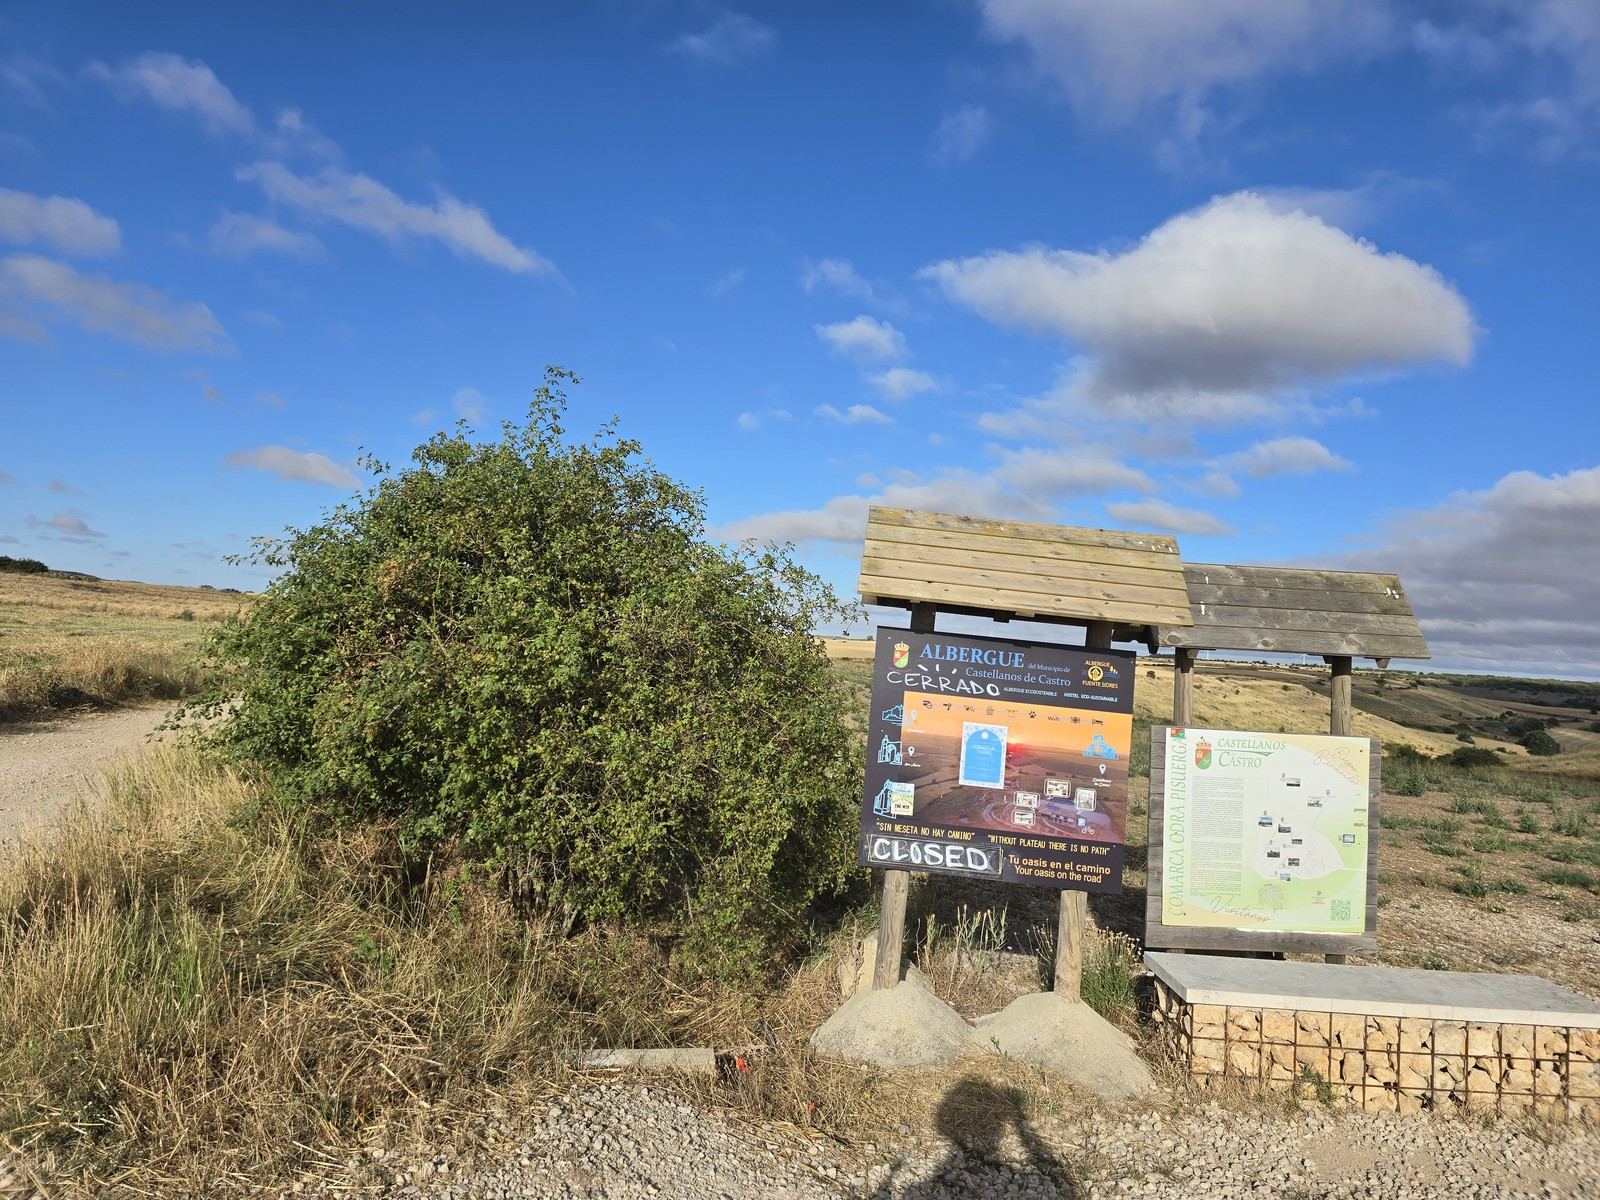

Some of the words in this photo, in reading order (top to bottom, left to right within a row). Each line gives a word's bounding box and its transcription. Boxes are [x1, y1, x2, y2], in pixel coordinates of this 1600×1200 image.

[919, 643, 1025, 669] ALBERGUE
[1036, 664, 1064, 673] Municipio
[1085, 660, 1110, 668] ALBERGUE
[887, 671, 1000, 696] CERRADO
[965, 667, 1022, 682] Castellanos
[1024, 673, 1036, 683] de
[1038, 675, 1071, 687] Castro
[1082, 680, 1101, 688] FUENTE
[1081, 694, 1118, 702] ECO-SUSTAINABLE
[1217, 738, 1286, 750] CASTELLANOS
[876, 822, 892, 832] "SIN
[894, 824, 918, 835] MESETA
[921, 827, 930, 835] NO
[932, 828, 945, 837] HAY
[947, 830, 975, 840] CAMINO"
[1169, 805, 1185, 843] ODRA
[873, 838, 988, 871] CLOSED
[988, 834, 1016, 846] "WITHOUT
[1019, 838, 1046, 849] PLATEAU
[1049, 841, 1067, 851] THERE
[1071, 843, 1078, 852] IS
[1080, 844, 1089, 853] NO
[1091, 845, 1110, 856] PATH"
[1008, 854, 1019, 865] Tu
[1022, 857, 1047, 868] oasis
[1050, 861, 1062, 869] en
[1064, 860, 1074, 871] el
[1076, 863, 1111, 875] camino
[1014, 865, 1032, 877] Your
[1034, 867, 1054, 878] oasis
[1057, 871, 1067, 880] on
[1069, 870, 1081, 881] the
[1084, 872, 1101, 884] road
[1168, 848, 1185, 917] COMARCA
